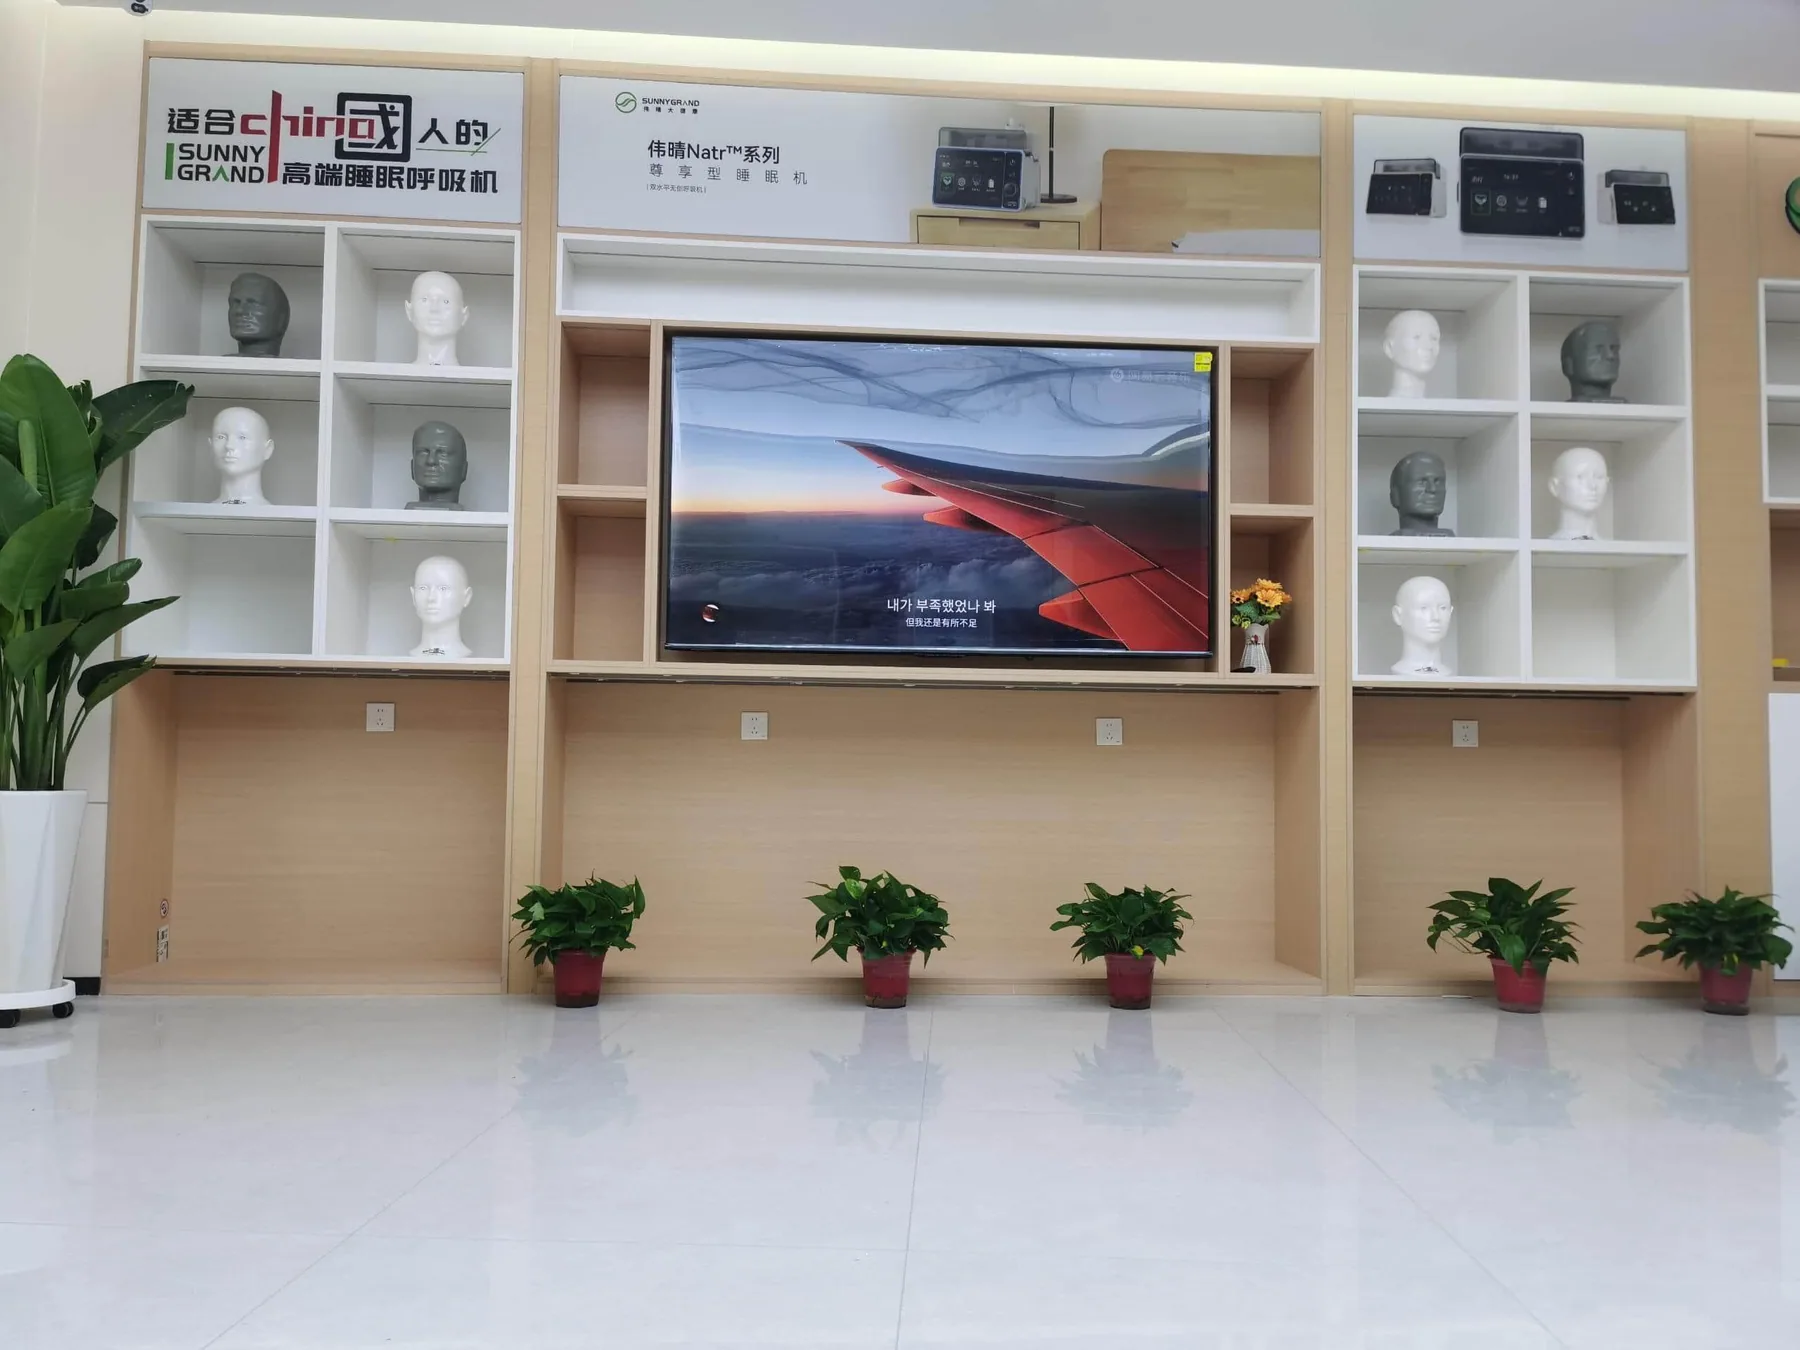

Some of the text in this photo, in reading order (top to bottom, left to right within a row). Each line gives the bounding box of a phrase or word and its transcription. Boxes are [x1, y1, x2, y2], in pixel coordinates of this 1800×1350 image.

[641, 97, 700, 107] SUNNYGRAND
[178, 143, 265, 163] SUNNY
[177, 164, 265, 183] GRAND
[282, 162, 498, 194] 高端睡眠呼吸机
[649, 163, 808, 185] 尊享型睡眠机
[887, 598, 997, 614] 내가 부족했었나 봐
[905, 617, 978, 628] 但我还是有所不足
